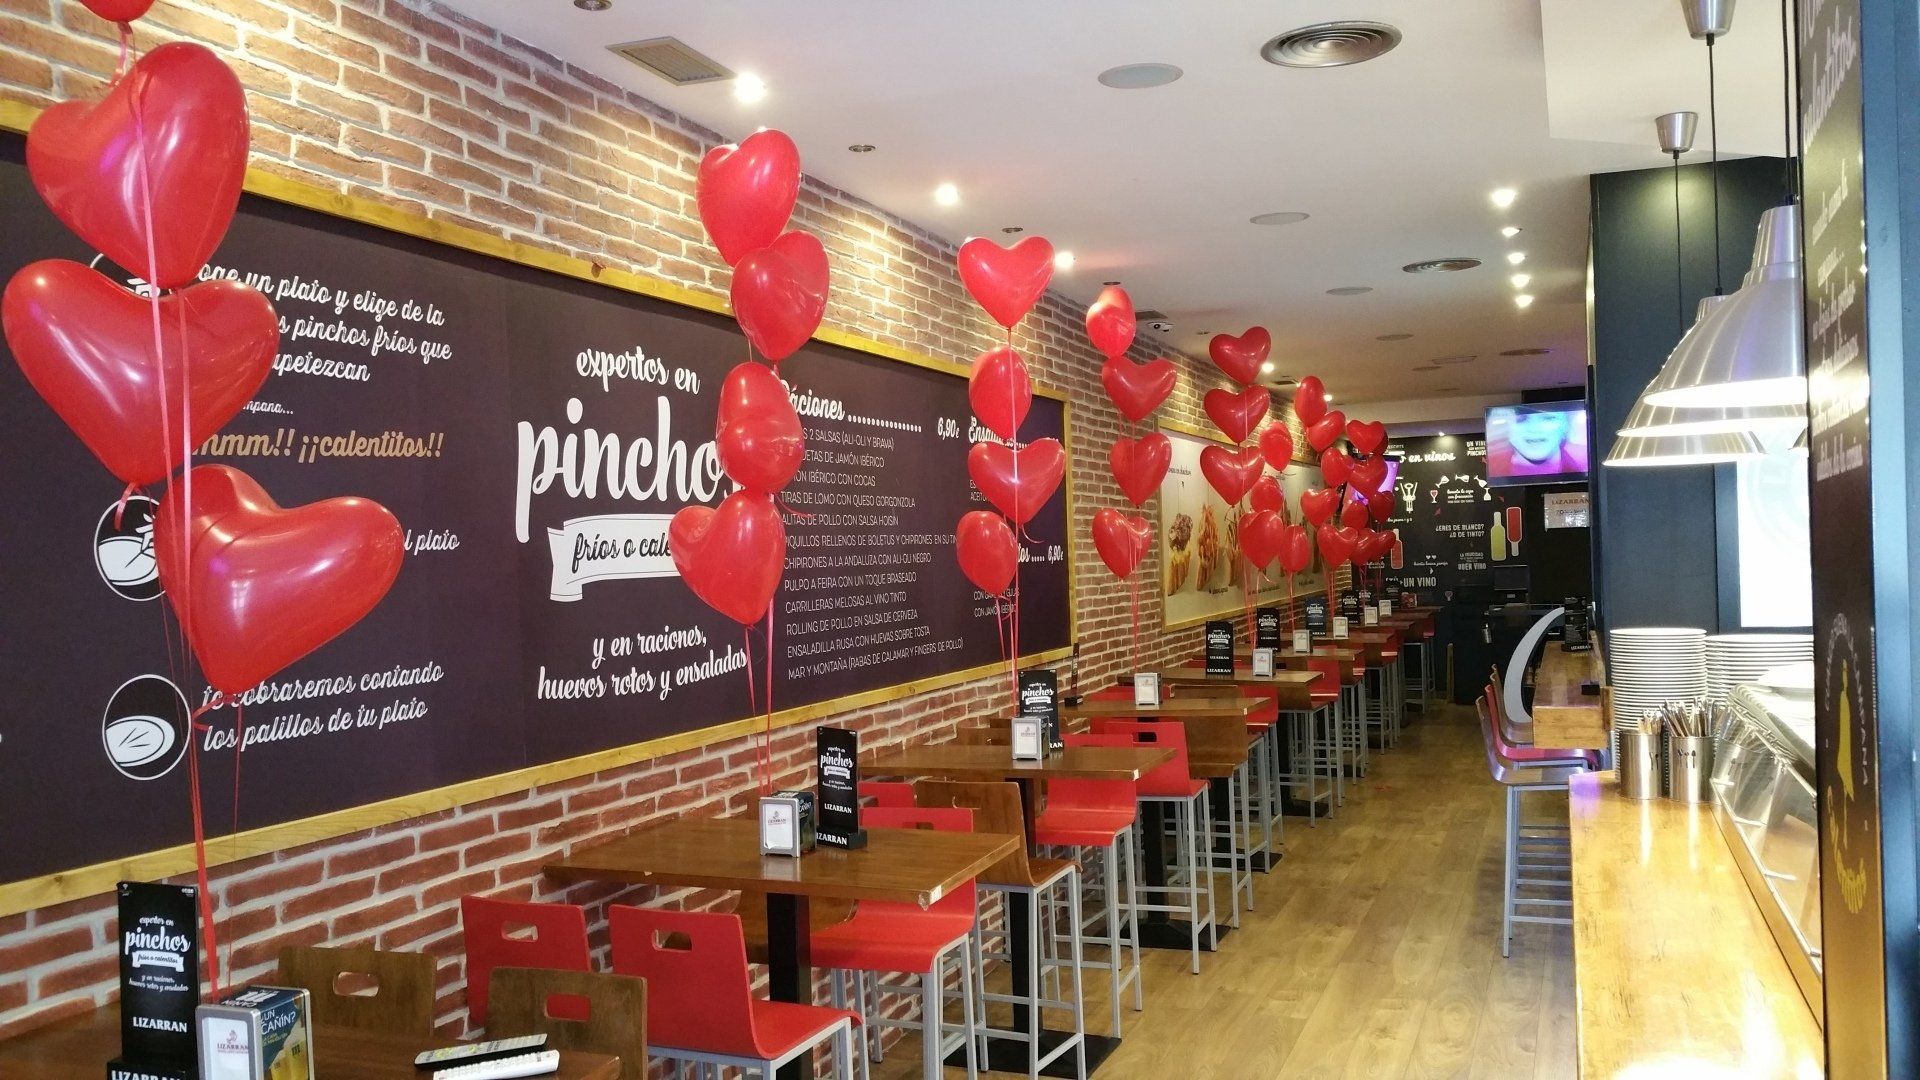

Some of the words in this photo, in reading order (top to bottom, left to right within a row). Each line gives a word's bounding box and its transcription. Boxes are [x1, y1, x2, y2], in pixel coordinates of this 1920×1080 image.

[244, 272, 274, 293] un
[276, 275, 331, 304] plato
[334, 289, 349, 315] y
[353, 290, 398, 322] elige
[401, 299, 423, 321] de
[426, 303, 445, 326] la
[291, 315, 370, 347] pinchos
[371, 325, 417, 357] fríos
[420, 340, 452, 364] que
[576, 346, 670, 393] expertos
[674, 366, 701, 395] en
[809, 429, 814, 440] 2
[815, 428, 841, 444] SALSAS
[872, 436, 895, 451] BRAVA)
[824, 451, 834, 463] DE
[835, 451, 859, 465] JAMÓN
[860, 453, 885, 468] IBÉRICO
[808, 468, 836, 484] IBÉRICO
[837, 473, 853, 486] CON
[853, 475, 876, 487] COCAS
[781, 490, 802, 504] TIRAS
[803, 492, 813, 504] DE
[814, 492, 835, 506] LOMO
[837, 493, 853, 506] CON
[853, 494, 875, 508] QUESO
[875, 495, 916, 508] GORGONZOLA
[807, 513, 817, 526] DE
[818, 513, 841, 527] POLLO
[842, 513, 858, 526] CON
[858, 514, 879, 527] SALSA
[879, 514, 899, 527] HOISIN
[404, 529, 413, 551] l
[414, 529, 460, 556] plato
[821, 534, 857, 547] RELLENOS
[857, 534, 867, 546] DE
[868, 534, 895, 546] BOLETUS
[901, 534, 933, 545] CHIPIRONES
[934, 534, 942, 545] EN
[942, 534, 950, 545] SU
[572, 532, 620, 574] fríos
[623, 538, 637, 558] o
[783, 556, 828, 570] CHIPIRONES
[828, 556, 834, 567] A
[834, 556, 843, 567] LA
[844, 554, 878, 567] ANDALUZA
[878, 553, 892, 565] CON
[912, 552, 932, 563] NEGRO
[784, 578, 810, 592] PULPO
[811, 579, 817, 589] A
[817, 576, 838, 588] FEIRA
[838, 575, 854, 588] CON
[855, 575, 864, 586] UN
[865, 573, 886, 587] TOQUE
[886, 571, 917, 584] BRASEADO
[1403, 577, 1415, 588] UN
[1417, 576, 1437, 587] VINO
[785, 597, 834, 614] CARRILLERAS
[834, 594, 865, 609] MELOSAS
[865, 594, 874, 605] AL
[874, 592, 889, 605] VINO
[889, 591, 907, 602] TINTO
[786, 620, 819, 636] ROLLING
[820, 619, 830, 632] DE
[831, 616, 853, 630] POLLO
[854, 615, 863, 627] EN
[863, 612, 883, 626] SALSA
[883, 611, 892, 623] DE
[892, 608, 919, 622] CERVEZA
[591, 636, 605, 670] y
[610, 637, 633, 658] en
[637, 625, 708, 655] raciones,
[787, 640, 836, 659] ENSALADILLA
[836, 638, 854, 650] RUSA
[855, 635, 870, 647] CON
[894, 628, 914, 641] SOBRE
[914, 625, 931, 638] TOSTA
[788, 666, 806, 680] MAR
[806, 665, 812, 677] Y
[813, 657, 847, 676] MONTAÑA
[848, 655, 871, 671] (RABAS
[872, 652, 881, 665] DE
[881, 646, 910, 663] CALAMAR
[914, 642, 937, 656] FINGERS
[937, 641, 945, 652] DE
[945, 637, 964, 650] POLLO)
[360, 661, 444, 691] contando
[537, 665, 608, 700] huevos
[611, 666, 656, 697] rotos
[659, 668, 671, 701] y
[676, 644, 748, 687] ensaladas
[1021, 686, 1055, 701] pinchos
[203, 725, 239, 752] los
[240, 713, 324, 753] palillos
[327, 707, 353, 733] de
[356, 704, 378, 728] tu
[378, 697, 428, 730] plato
[820, 752, 854, 769] pinchos
[824, 803, 852, 814] LIZARRAN
[816, 832, 848, 845] IZARRAN
[125, 926, 191, 955] pinchos
[132, 1016, 188, 1033] LIZARRAN
[261, 1011, 296, 1035] CAÑÍN?
